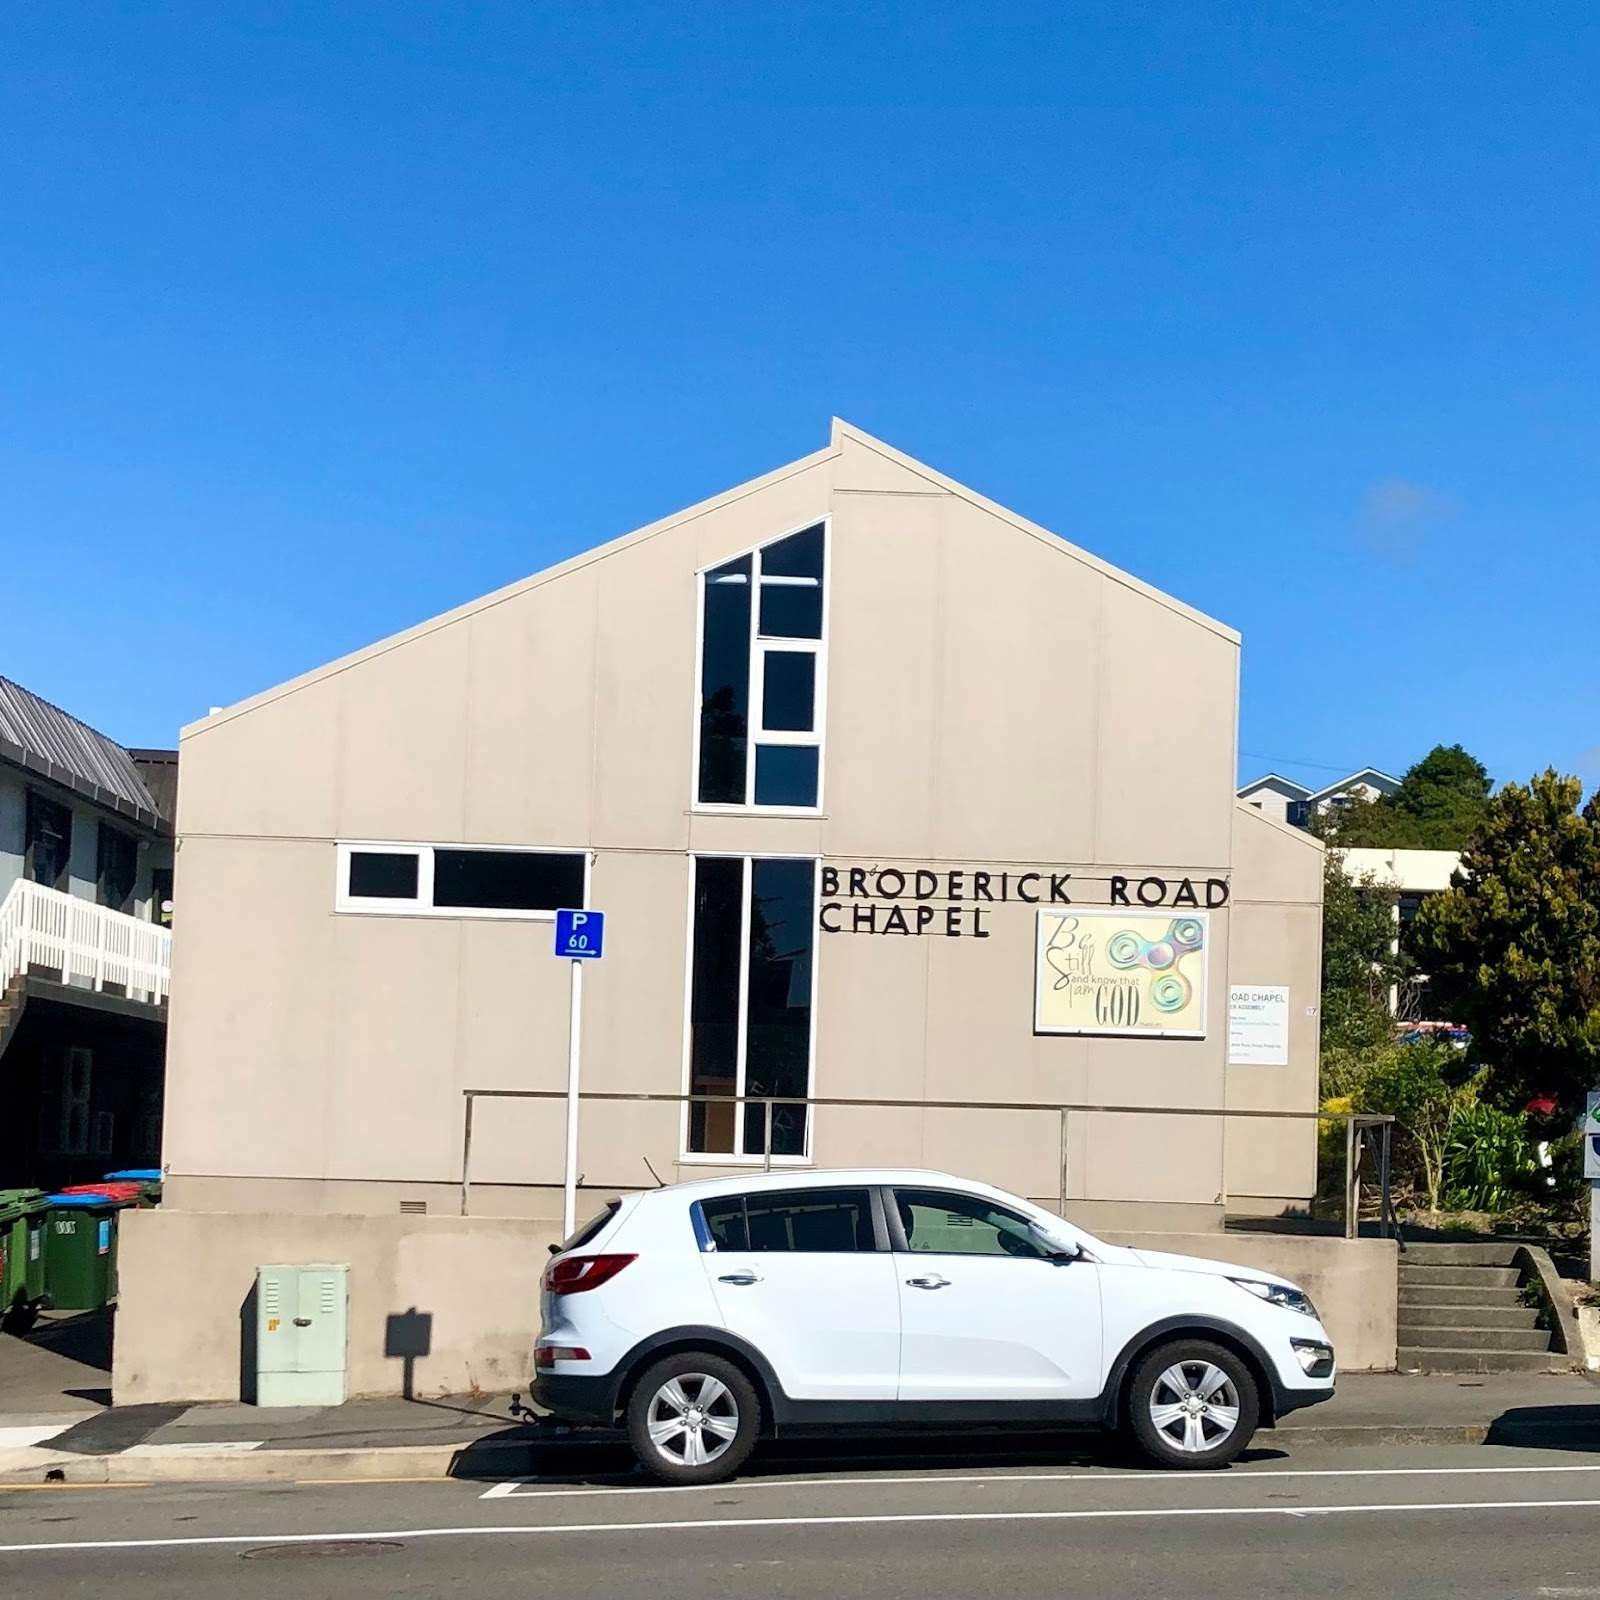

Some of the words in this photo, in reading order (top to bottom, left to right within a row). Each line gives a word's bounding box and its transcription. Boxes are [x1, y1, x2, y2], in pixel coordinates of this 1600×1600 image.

[820, 867, 1072, 904] BRODERICK
[1110, 875, 1230, 909] ROAD
[573, 913, 588, 931] P
[819, 902, 990, 938] CHAPEL
[1047, 915, 1092, 950] Be
[569, 934, 588, 949] 60
[1046, 944, 1095, 991] Still
[1071, 975, 1090, 985] and
[1091, 975, 1118, 985] know
[1119, 976, 1140, 987] that
[1073, 984, 1096, 996] am
[1095, 984, 1140, 1027] GOD
[1251, 993, 1286, 1004] CHAPEL
